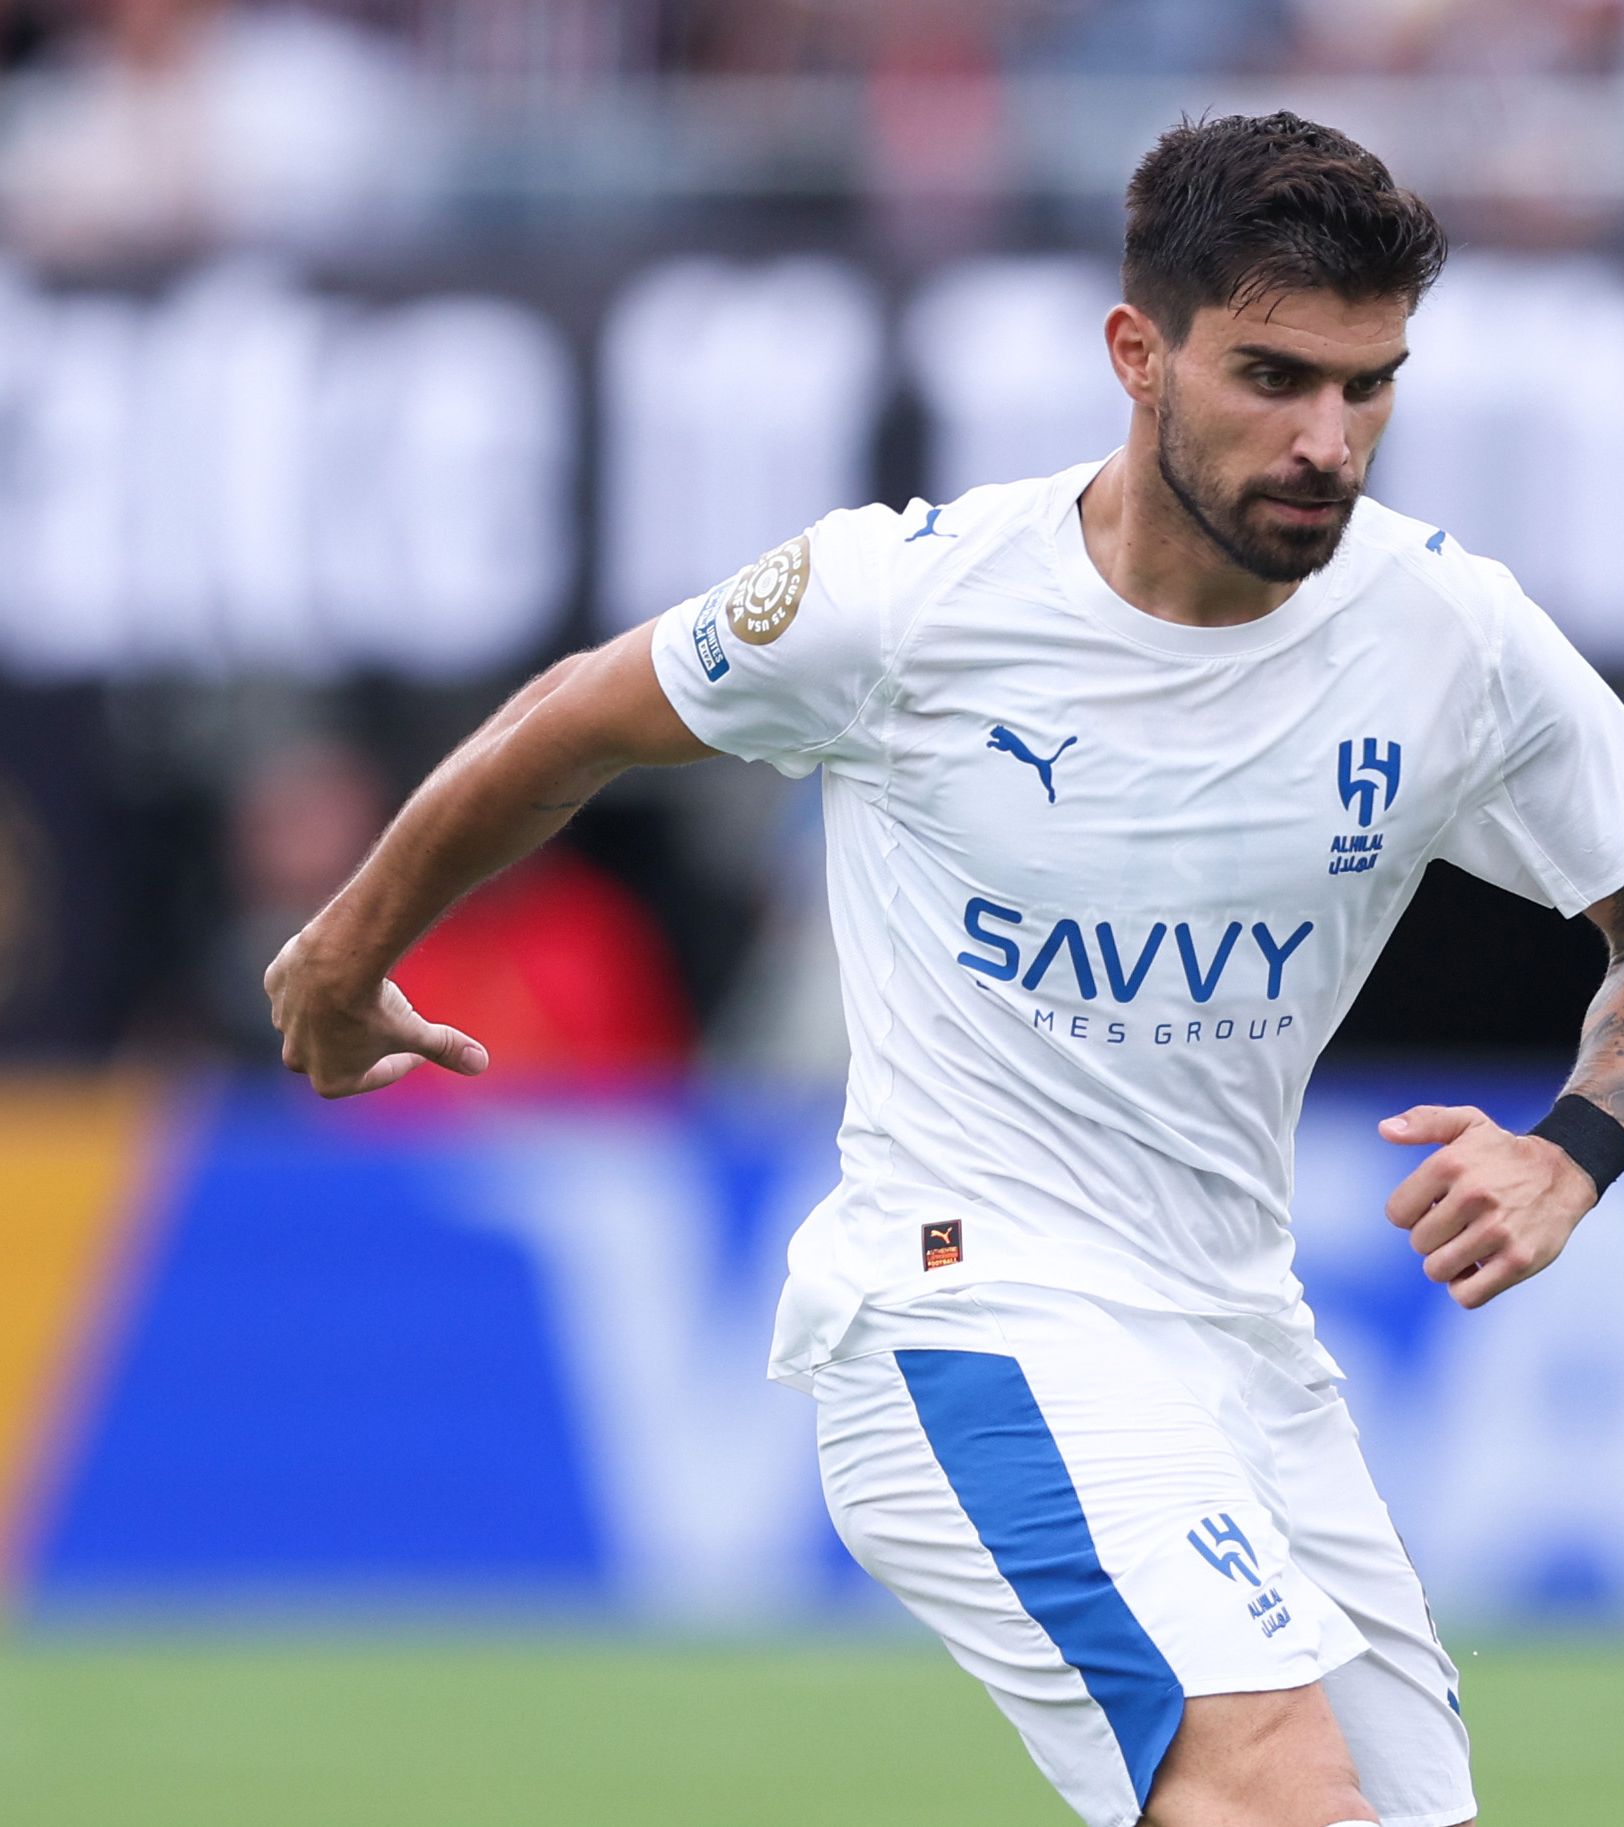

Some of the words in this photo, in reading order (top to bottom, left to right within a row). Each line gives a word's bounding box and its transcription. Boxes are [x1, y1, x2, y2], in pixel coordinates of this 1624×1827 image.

[784, 574, 801, 606] CUP
[747, 617, 770, 632] USA
[771, 606, 786, 625] 25
[956, 896, 1315, 1004] SAVVY
[1154, 1015, 1293, 1045] GROUP
